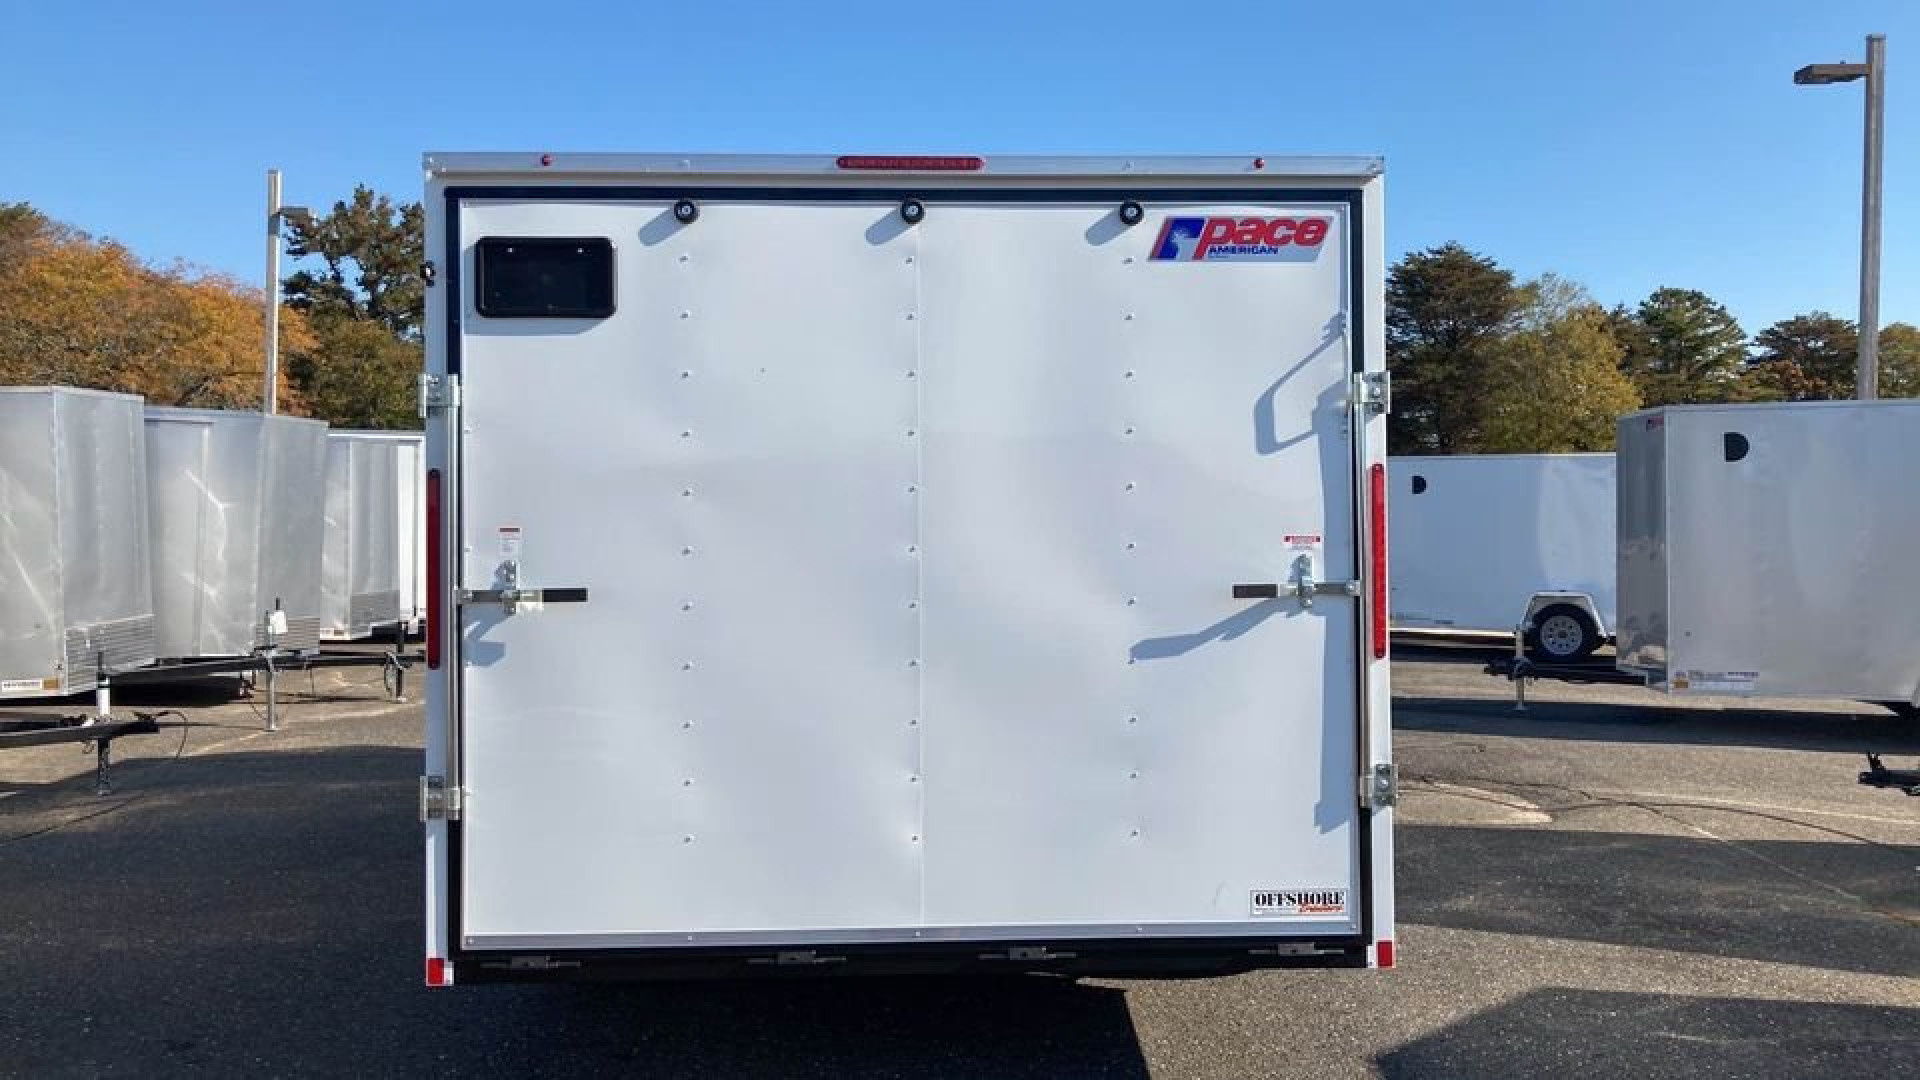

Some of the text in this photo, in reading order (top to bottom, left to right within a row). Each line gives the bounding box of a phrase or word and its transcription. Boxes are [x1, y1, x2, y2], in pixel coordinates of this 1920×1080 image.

[1192, 217, 1329, 260] pace
[1208, 245, 1279, 255] AMERICAN
[1255, 891, 1345, 906] OFFSHORE
